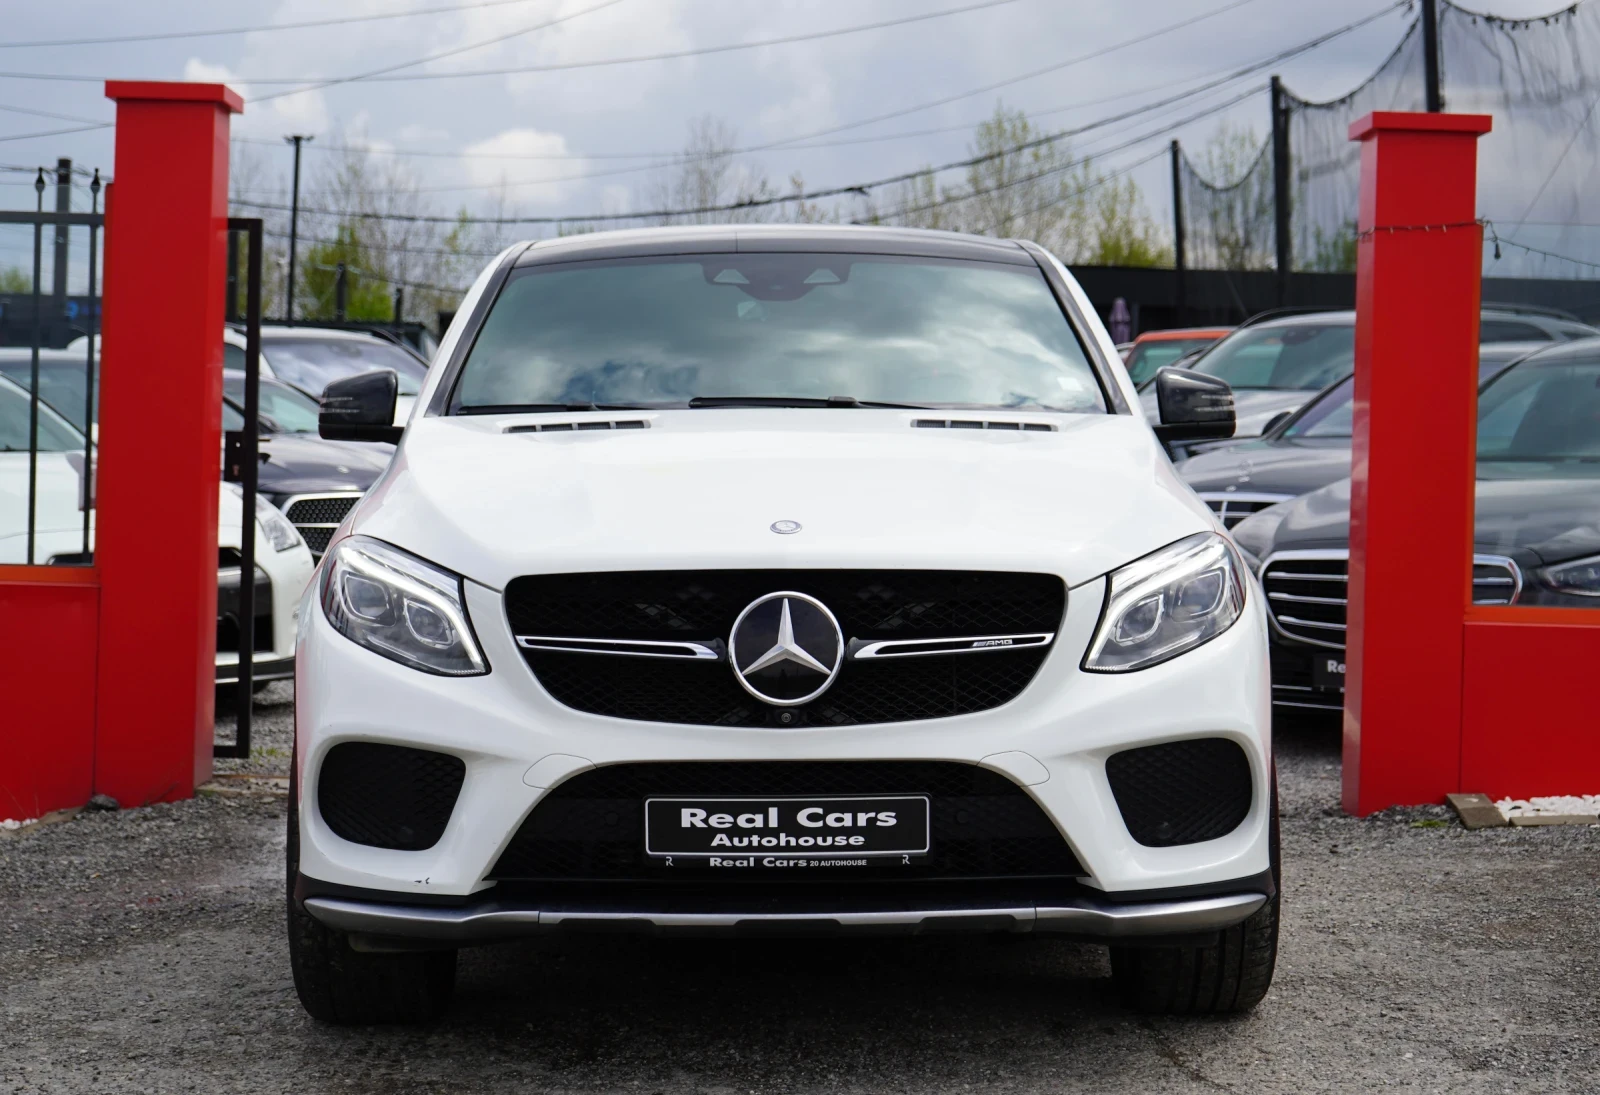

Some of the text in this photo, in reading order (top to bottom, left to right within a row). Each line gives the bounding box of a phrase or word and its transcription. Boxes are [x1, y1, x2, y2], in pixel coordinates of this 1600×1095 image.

[984, 638, 1013, 647] AMG
[680, 807, 898, 829] Real Cars
[710, 833, 866, 847] Autohouse
[709, 857, 755, 867] Real
[762, 857, 808, 867] Cars
[820, 859, 868, 867] AUTOHOUSE
